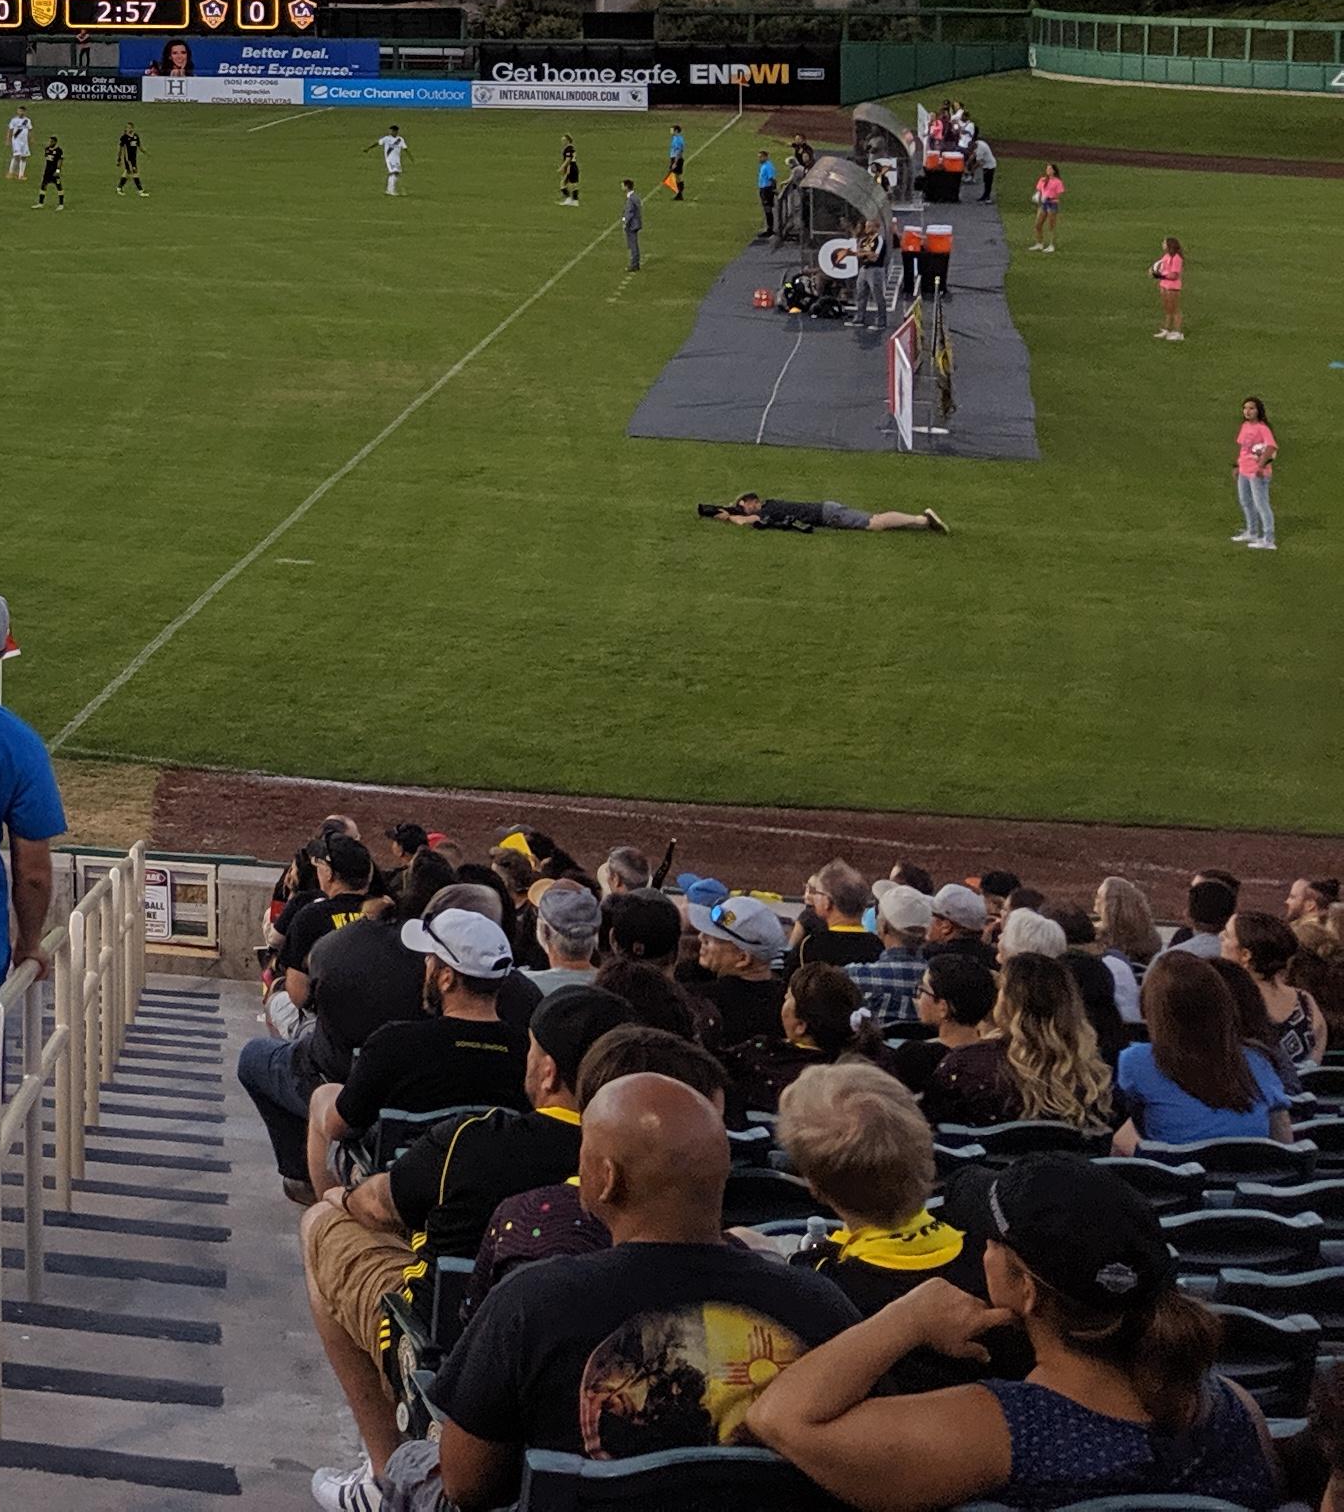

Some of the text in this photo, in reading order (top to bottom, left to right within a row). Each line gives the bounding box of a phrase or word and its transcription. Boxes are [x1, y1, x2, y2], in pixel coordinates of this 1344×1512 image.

[97, 1, 157, 23] 2:57
[205, 6, 222, 17] LA
[248, 1, 265, 23] 0
[294, 6, 311, 17] LA
[242, 46, 329, 59] Better Deal.
[218, 63, 265, 75] Better
[492, 62, 681, 85] Get home safe.
[689, 63, 790, 85] ENDWI
[92, 77, 107, 85] Only
[167, 79, 186, 96] H
[71, 84, 138, 94] RIO GRANDE
[330, 87, 466, 101] Clear Channel Outdoor
[499, 90, 621, 102] INTERNATIONALINDOOR.COM
